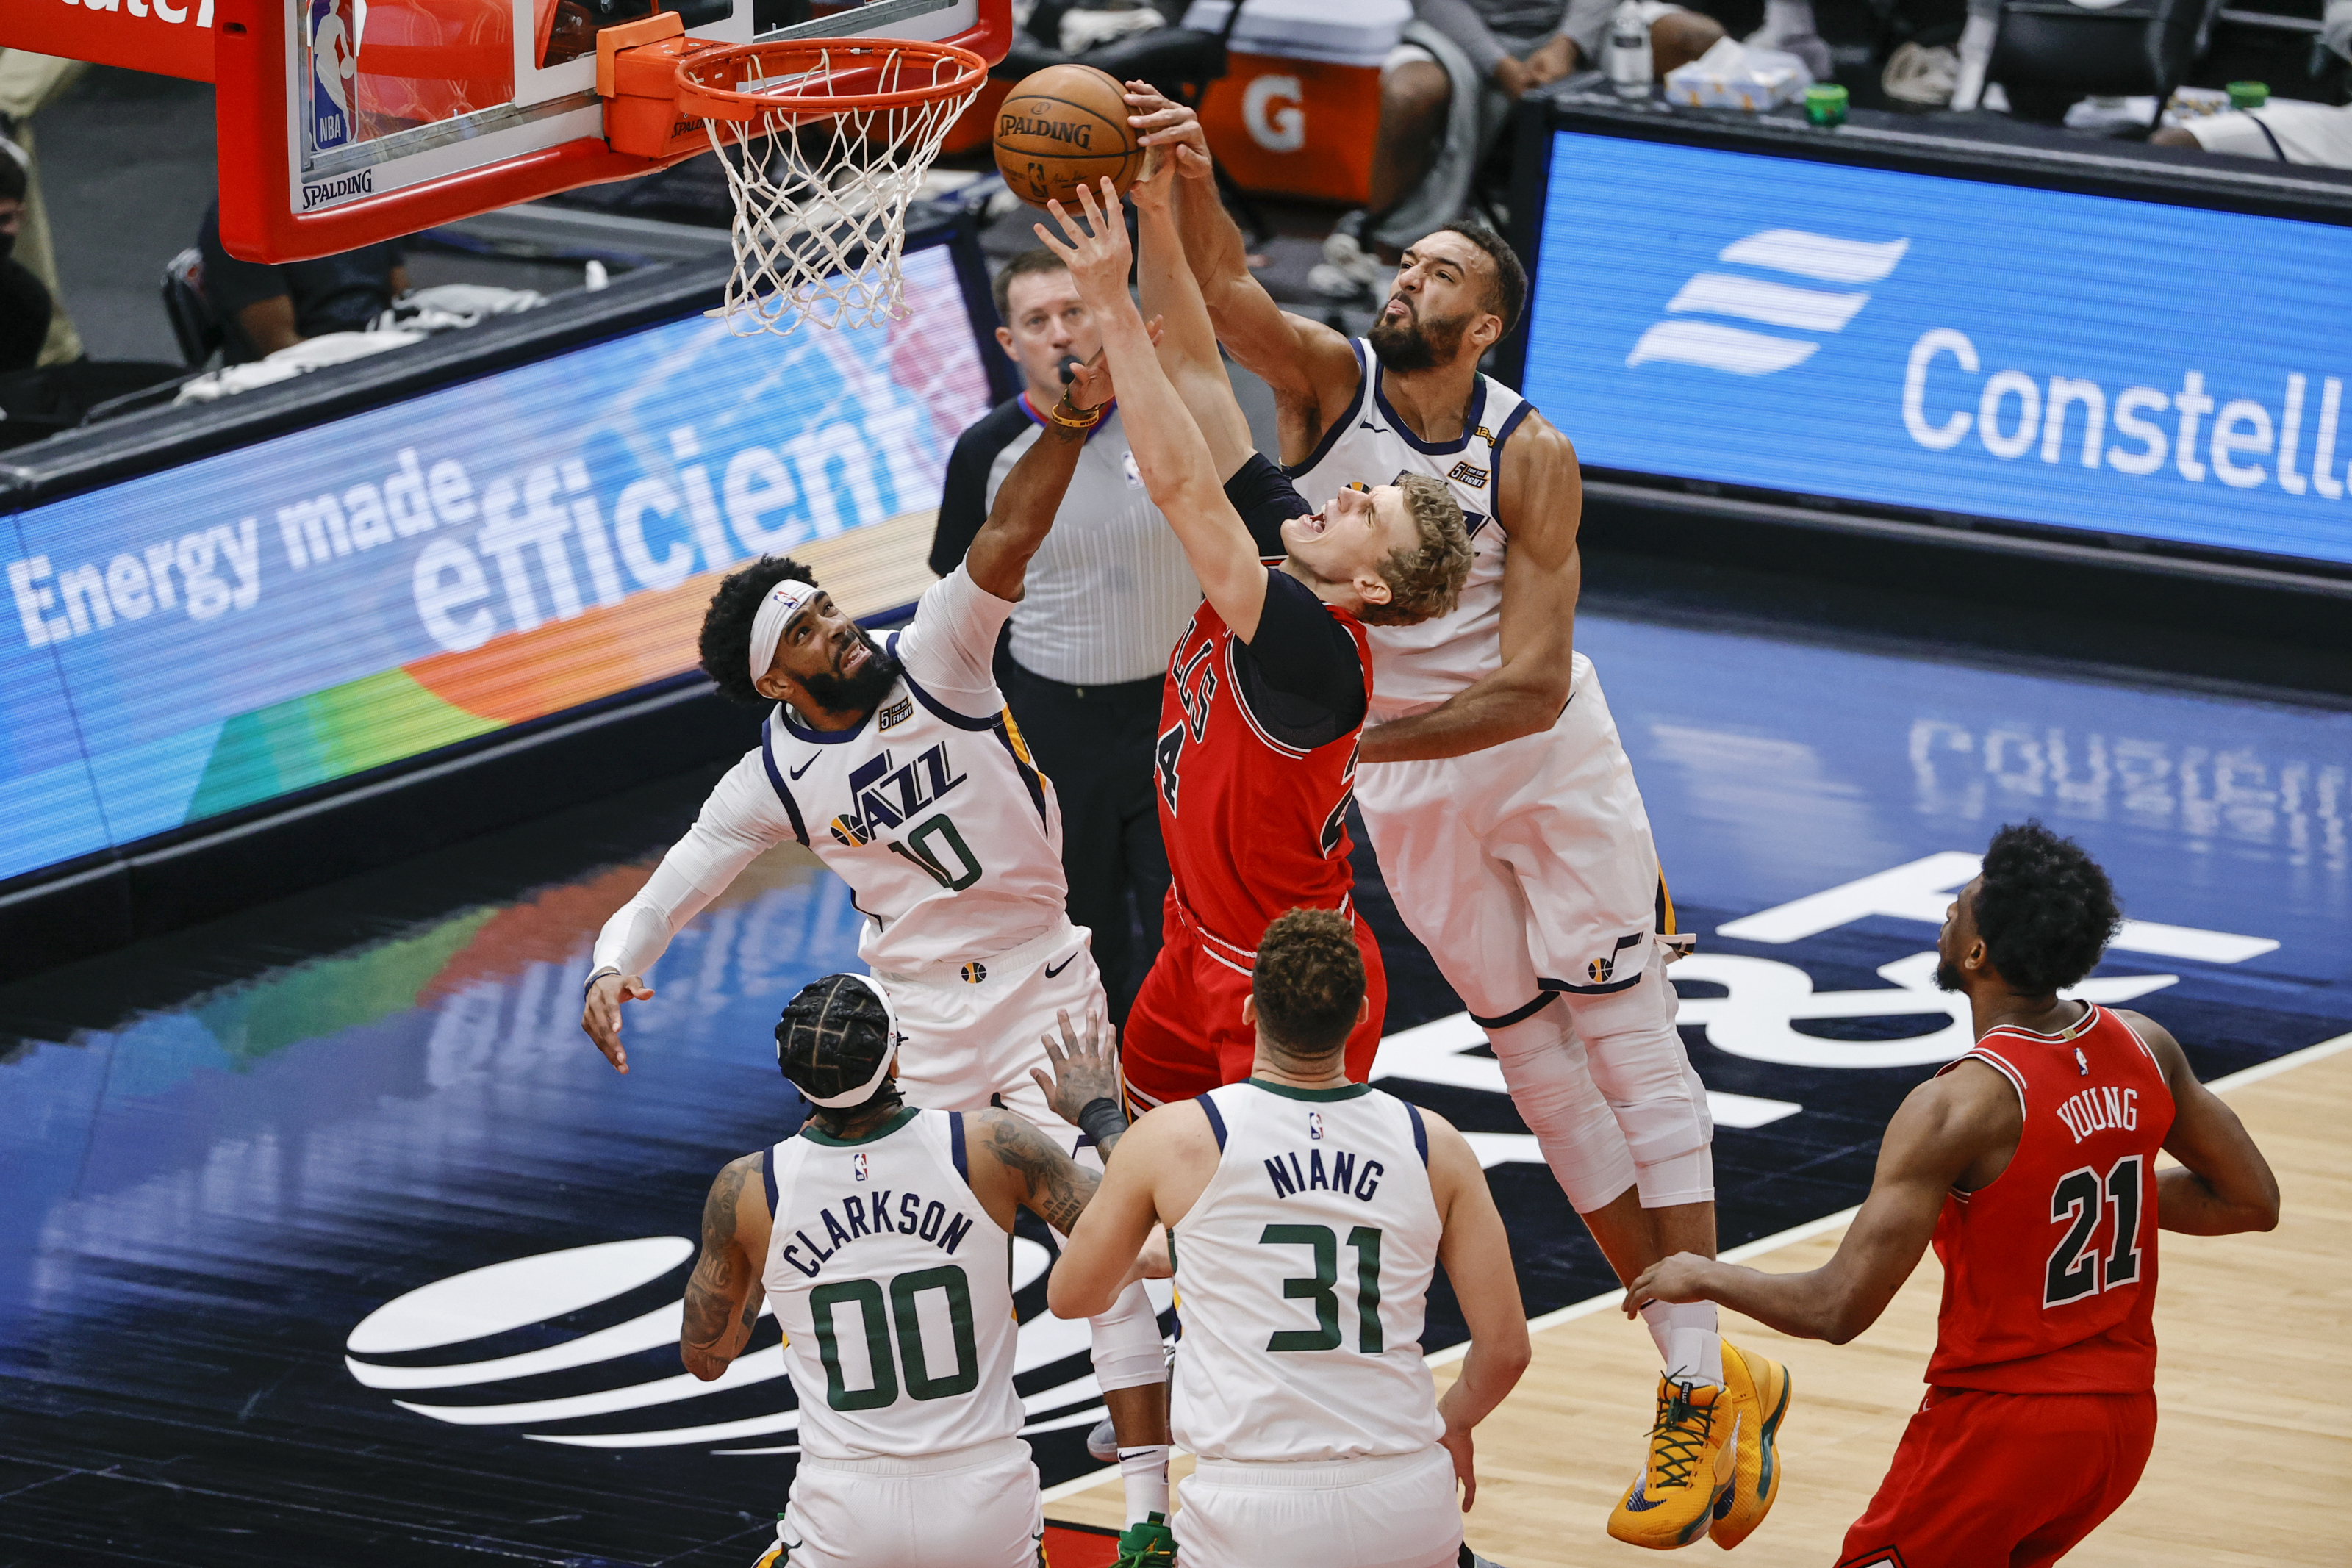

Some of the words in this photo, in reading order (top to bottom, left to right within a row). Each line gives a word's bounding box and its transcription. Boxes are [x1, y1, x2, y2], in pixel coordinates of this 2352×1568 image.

[320, 113, 342, 143] NBA
[999, 114, 1092, 150] SPALDING
[1242, 74, 1305, 151] G
[302, 168, 372, 210] SPALDING
[1902, 327, 2352, 500] Constell
[1451, 463, 1466, 478] 5
[1467, 466, 1477, 474] FOR
[1460, 474, 1485, 487] FIGHT
[6, 515, 261, 648] Energy
[276, 445, 479, 569] made
[412, 376, 942, 652] efficient
[881, 710, 889, 729] 5
[892, 705, 901, 713] FOR
[892, 705, 911, 724] FIGHT
[831, 740, 967, 847] JAZZ
[1155, 719, 1186, 819] 4
[887, 813, 983, 891] 10
[2056, 1086, 2137, 1144] YOUNG
[1263, 1148, 1384, 1202] NIANG
[783, 1190, 973, 1278] CLARKSON
[2043, 1154, 2143, 1310] 21
[1258, 1224, 1383, 1353] 31
[809, 1265, 979, 1411] 00
